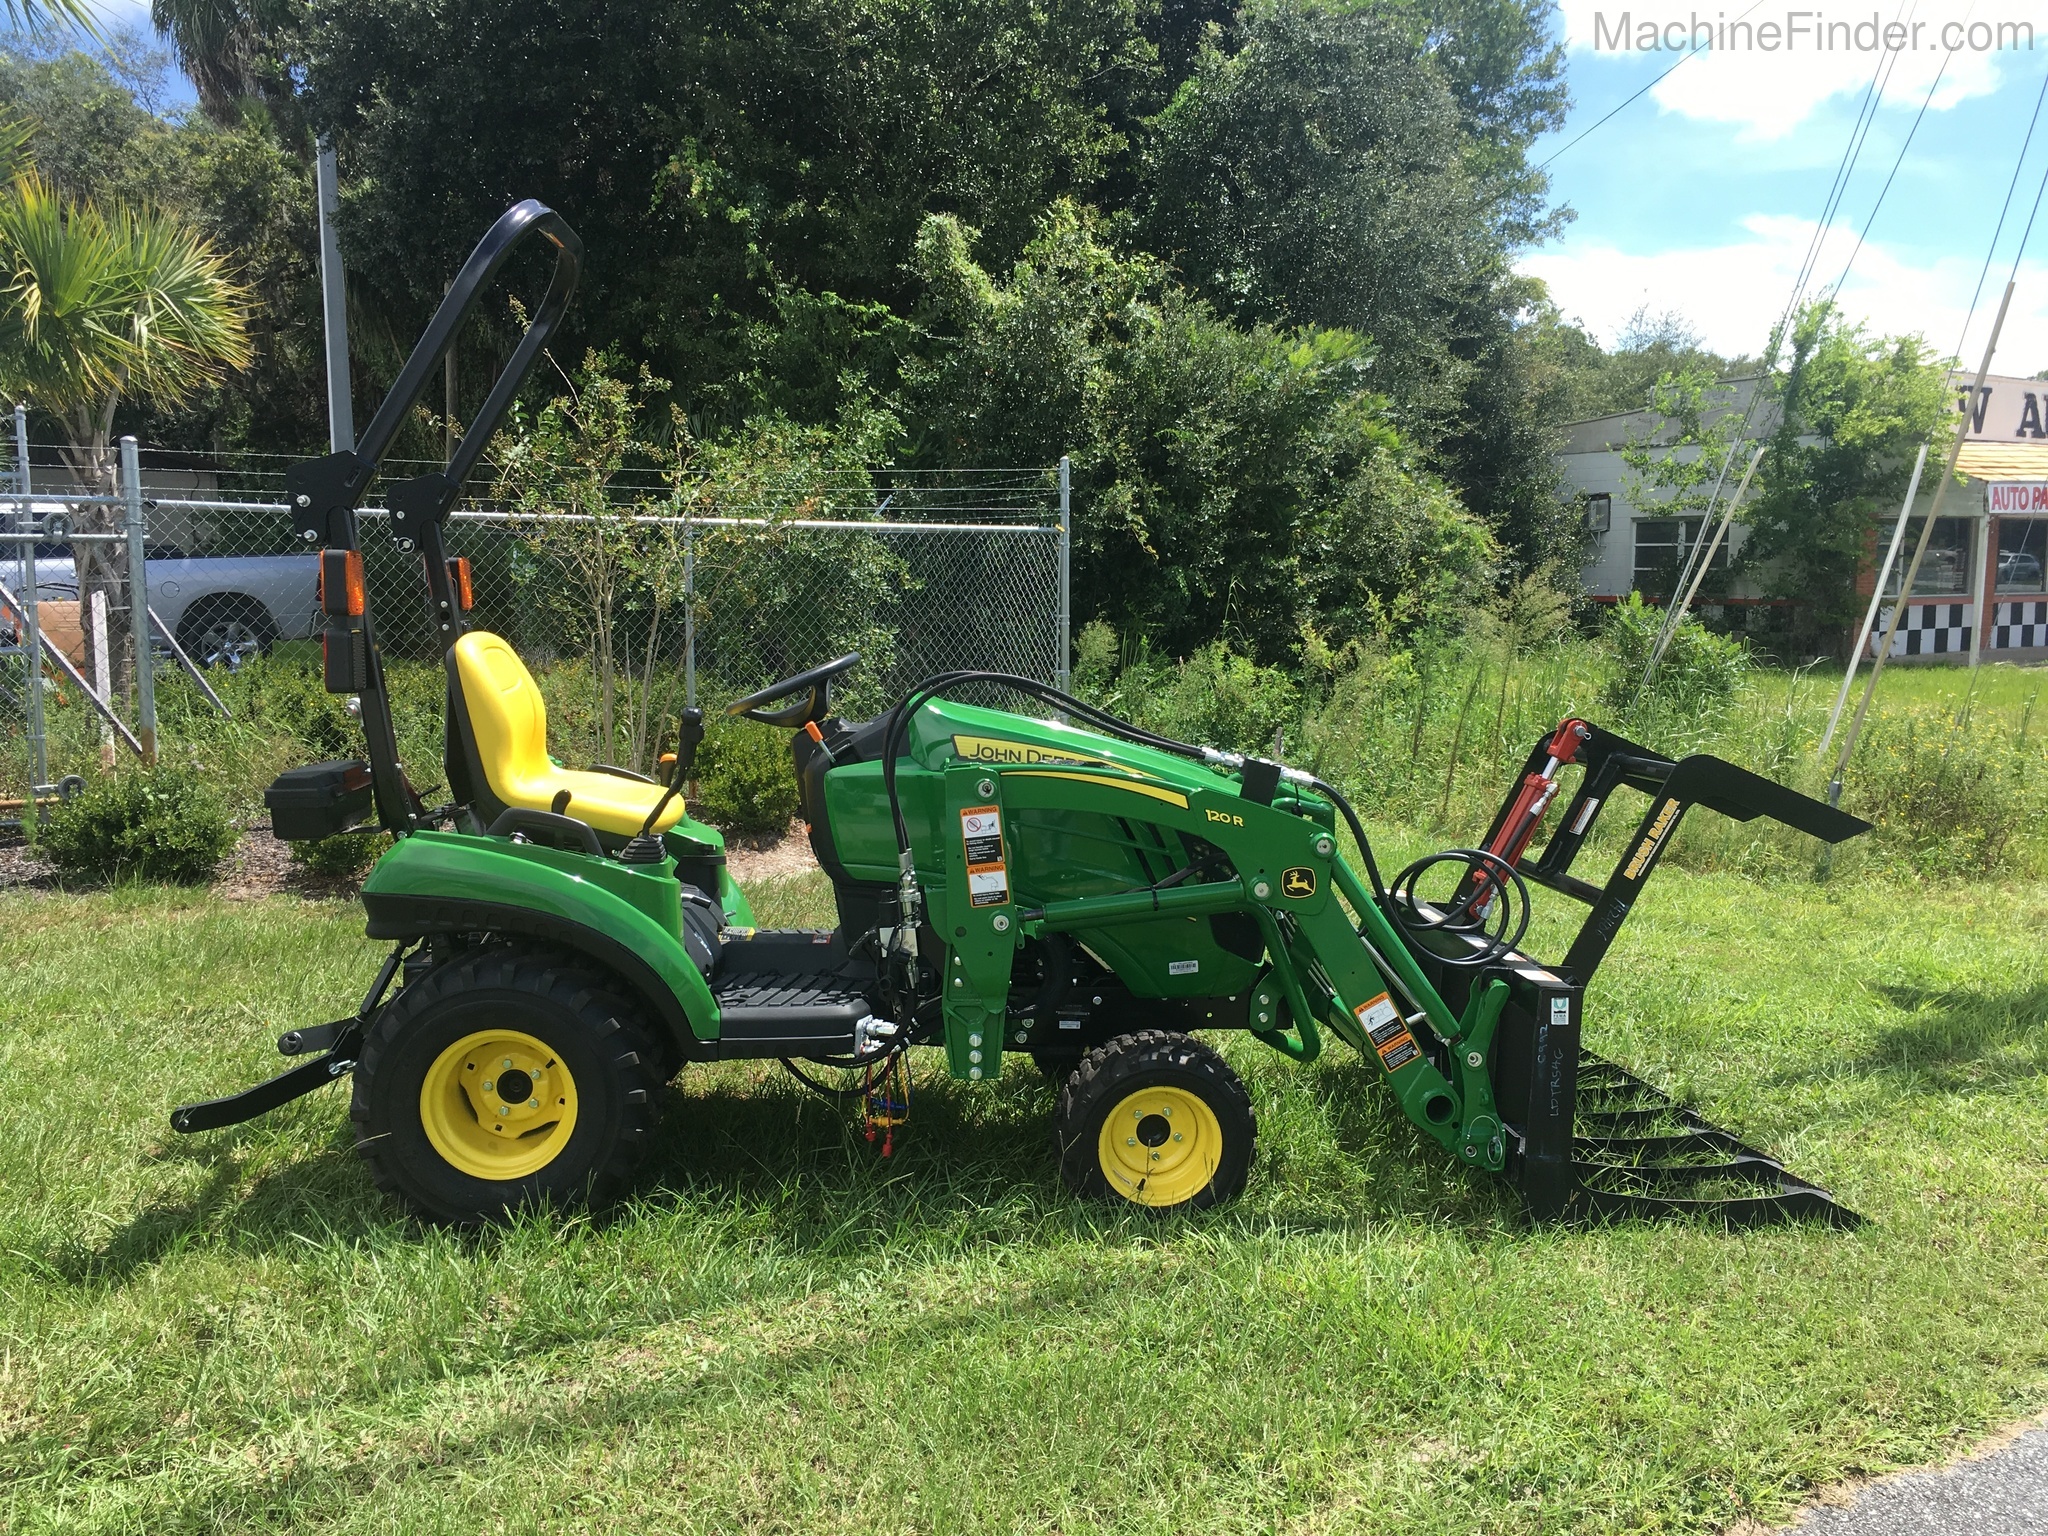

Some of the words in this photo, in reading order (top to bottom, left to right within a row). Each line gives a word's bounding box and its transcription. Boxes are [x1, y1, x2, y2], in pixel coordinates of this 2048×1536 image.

[2016, 392, 2048, 438] A
[1991, 486, 2029, 511] AUTO
[969, 743, 1021, 763] JOHN
[969, 806, 997, 815] WARNING
[1205, 809, 1231, 824] 120
[1232, 815, 1244, 827] R
[1623, 837, 1656, 880] BRUSH
[1648, 798, 1680, 840] RAKER
[975, 864, 1004, 873] WARNING
